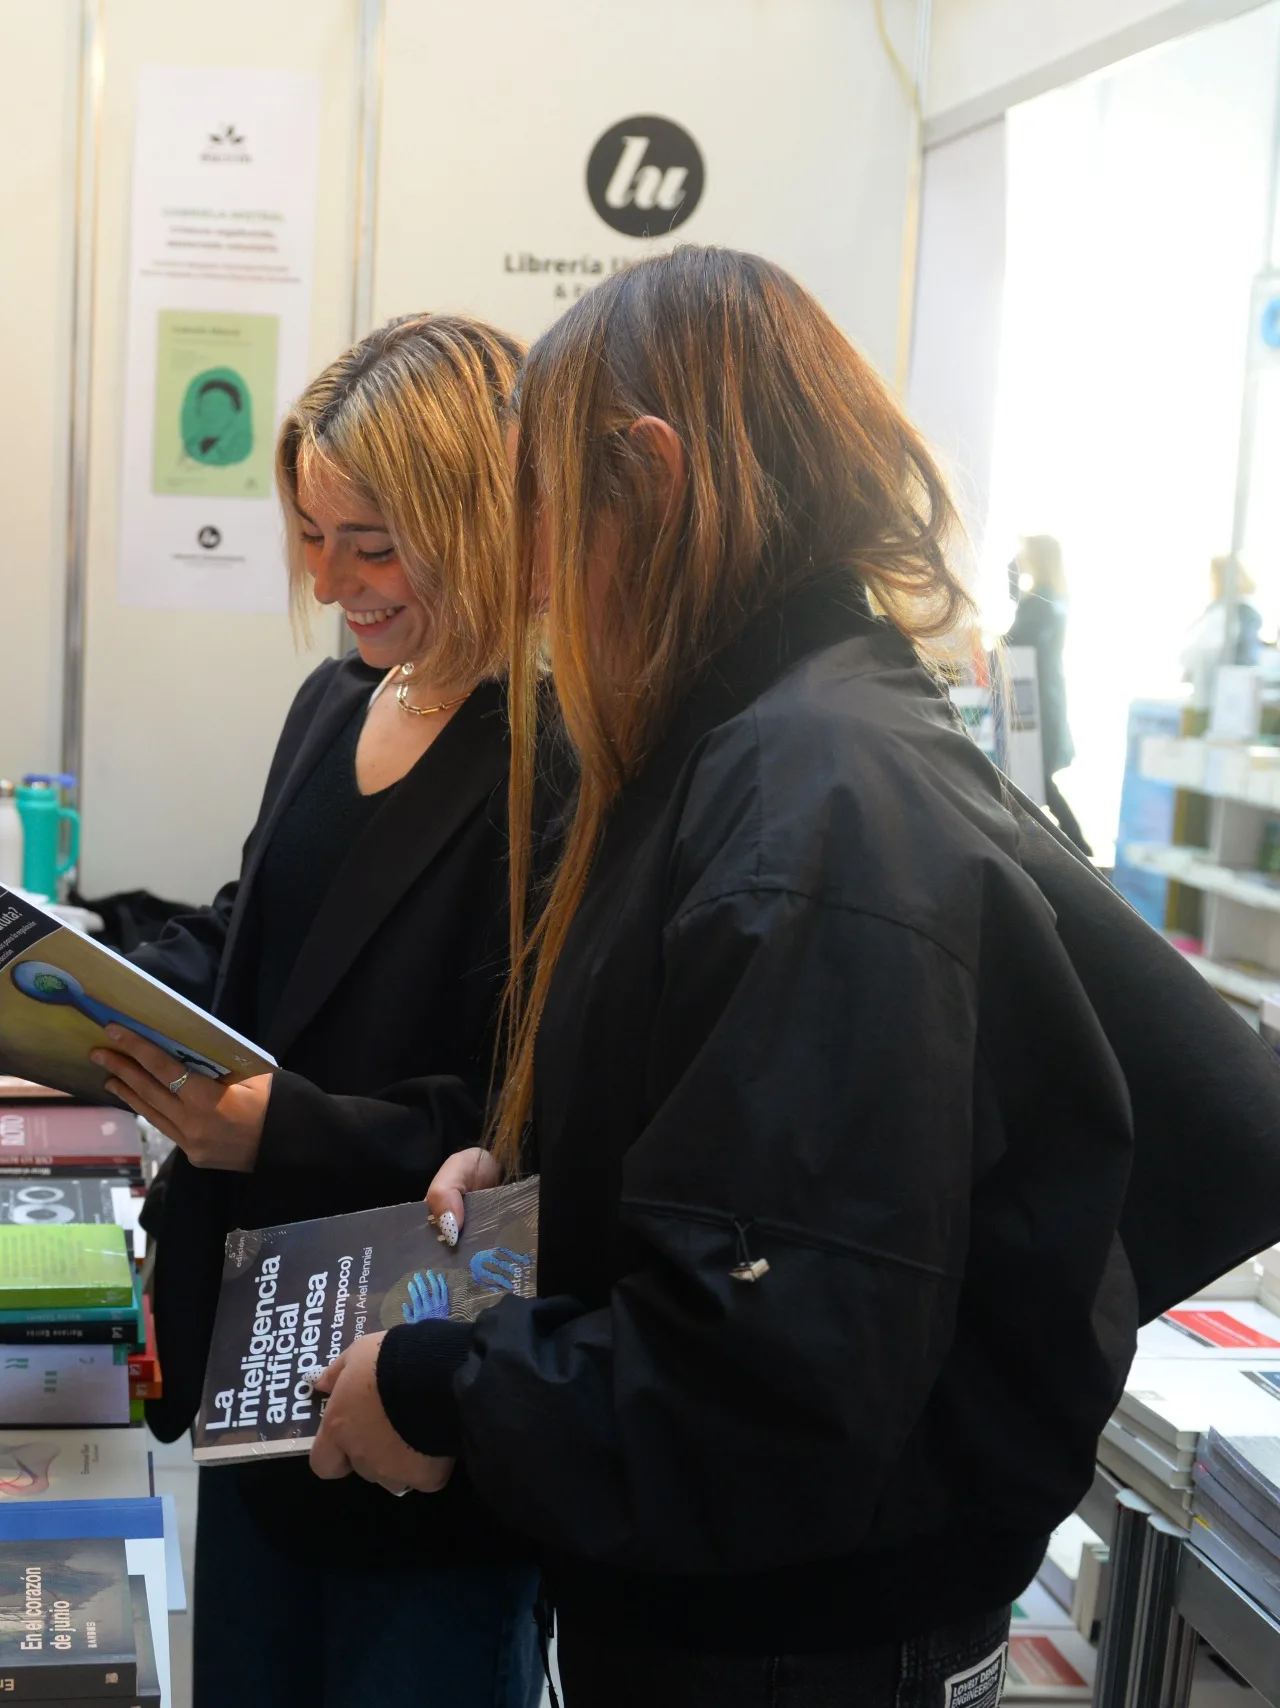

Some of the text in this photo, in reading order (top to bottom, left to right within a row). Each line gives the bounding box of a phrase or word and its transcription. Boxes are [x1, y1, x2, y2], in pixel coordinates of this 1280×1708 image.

[604, 135, 689, 211] lu
[504, 253, 604, 274] Librería
[0, 949, 14, 963] acción
[2, 934, 13, 947] para
[15, 921, 38, 937] regulación
[330, 1256, 353, 1327] tampoco)
[356, 1246, 374, 1309] Ariel Pennisi
[232, 1255, 281, 1427] inteligencia
[265, 1303, 300, 1424] artificial
[290, 1272, 328, 1421] no piensa
[205, 1389, 235, 1430] La
[21, 1566, 42, 1651] En el corazón
[50, 1600, 76, 1651] de junio
[953, 1658, 1000, 1697] LOVELY DENIM
